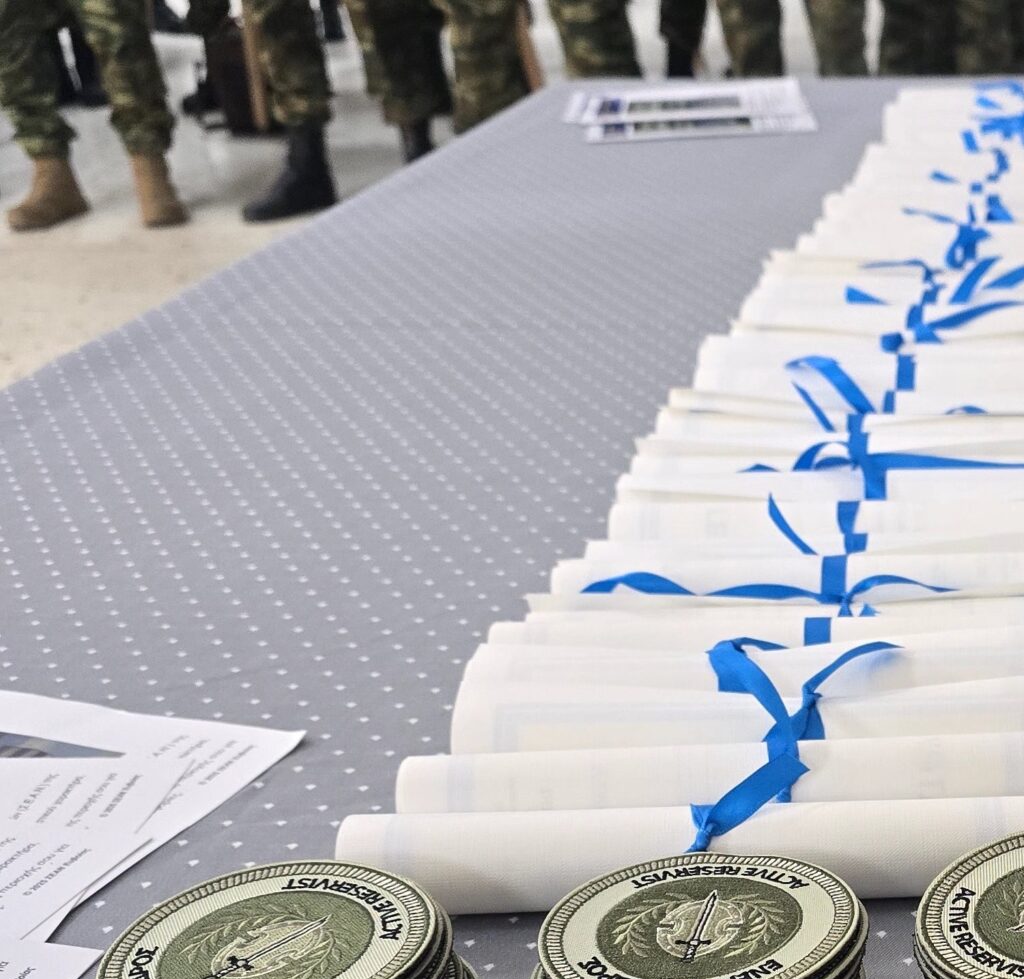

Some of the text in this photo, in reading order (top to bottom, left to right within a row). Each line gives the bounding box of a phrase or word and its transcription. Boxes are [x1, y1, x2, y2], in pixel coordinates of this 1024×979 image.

[631, 865, 810, 889] ACTIVE RESERVIST
[281, 878, 403, 940] ACTIVE RESERVIST
[949, 887, 976, 932] ACTIVE
